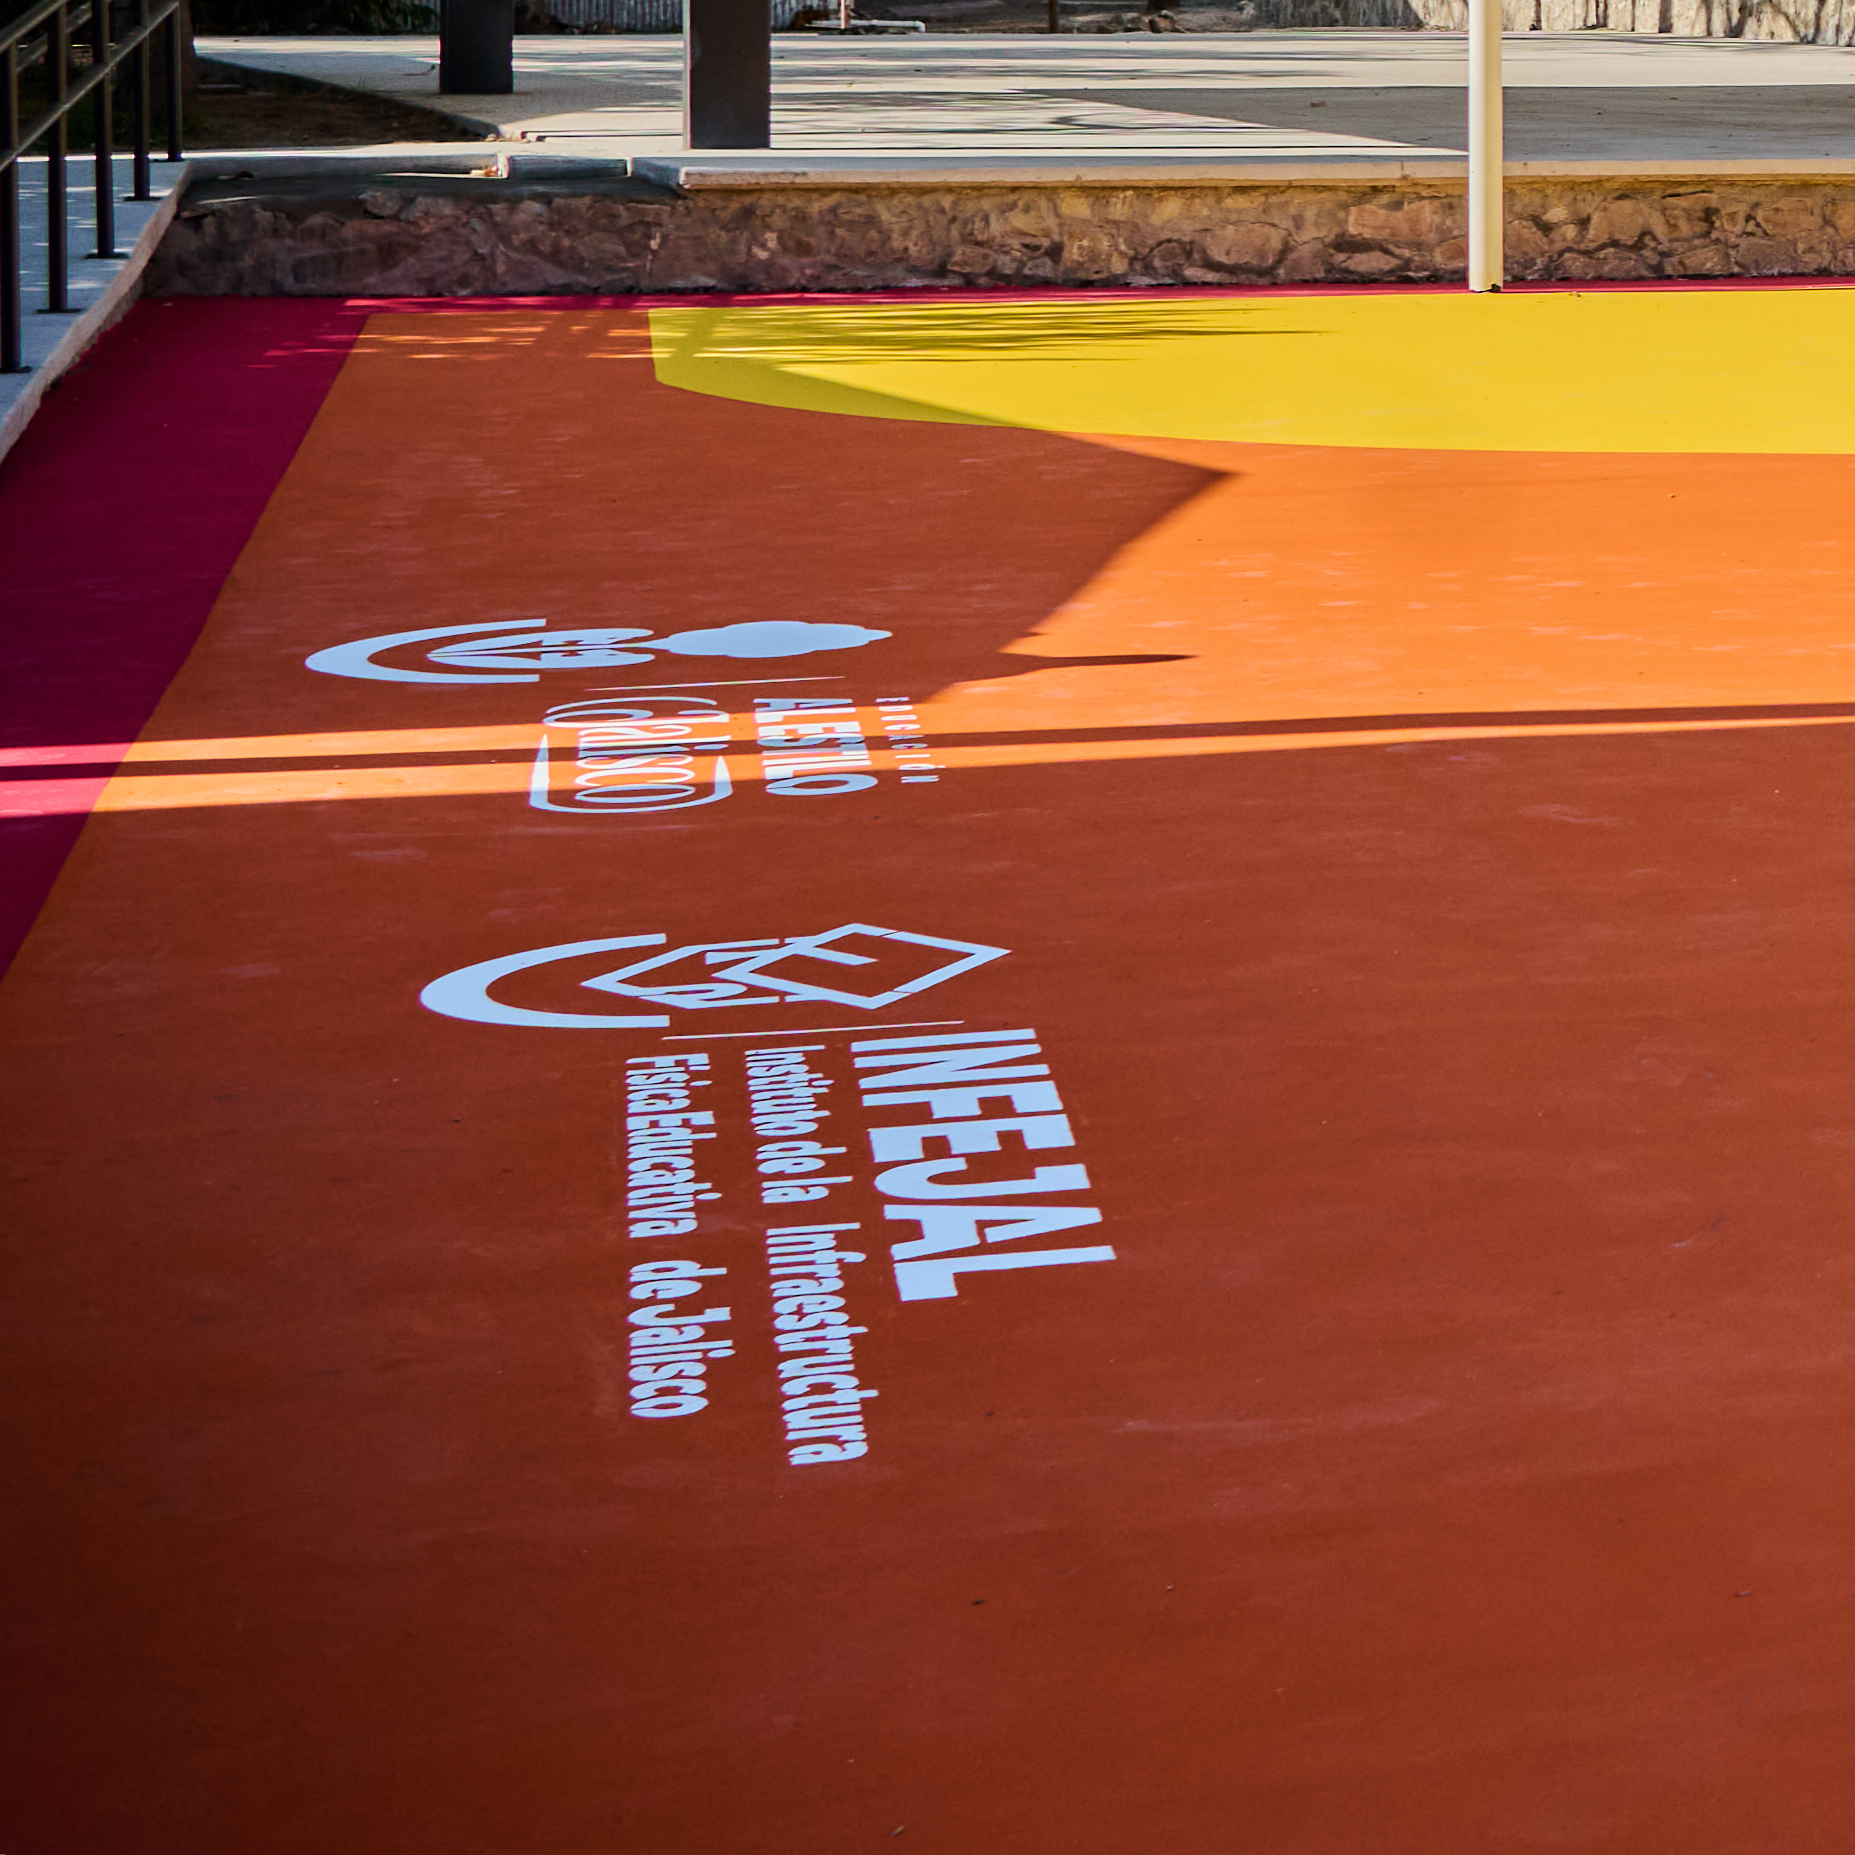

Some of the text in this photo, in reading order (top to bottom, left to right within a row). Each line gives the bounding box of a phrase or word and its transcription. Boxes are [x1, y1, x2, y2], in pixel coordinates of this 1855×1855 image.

[625, 1110, 723, 1239] Educativa
[850, 1028, 1117, 1302] INFEJAL
[628, 1259, 728, 1300] de
[745, 1045, 879, 1466] Instituto de la Infraestructura
[626, 1303, 736, 1419] Jalisco
